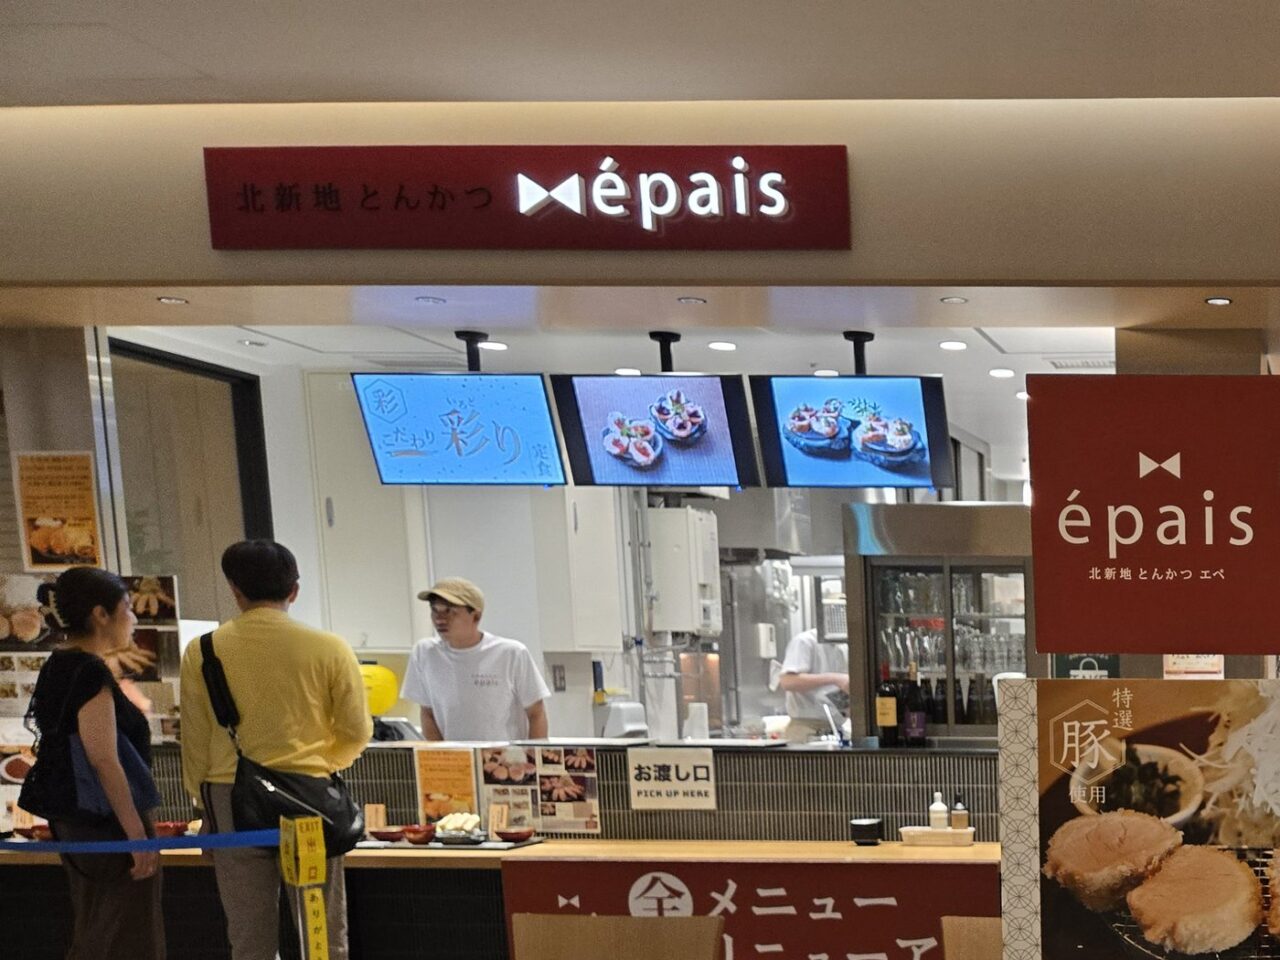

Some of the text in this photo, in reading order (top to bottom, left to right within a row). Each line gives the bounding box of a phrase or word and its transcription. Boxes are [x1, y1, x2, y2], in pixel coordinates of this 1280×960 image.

[360, 184, 493, 212] とんかつ
[591, 155, 790, 231] épais
[438, 408, 521, 466] 彩り
[1057, 488, 1254, 559] épais
[1112, 687, 1133, 731] 特選
[1060, 719, 1117, 769] 豚
[634, 763, 710, 781] お渡し口
[299, 821, 320, 834] EXIT
[708, 879, 898, 920] メニュー
